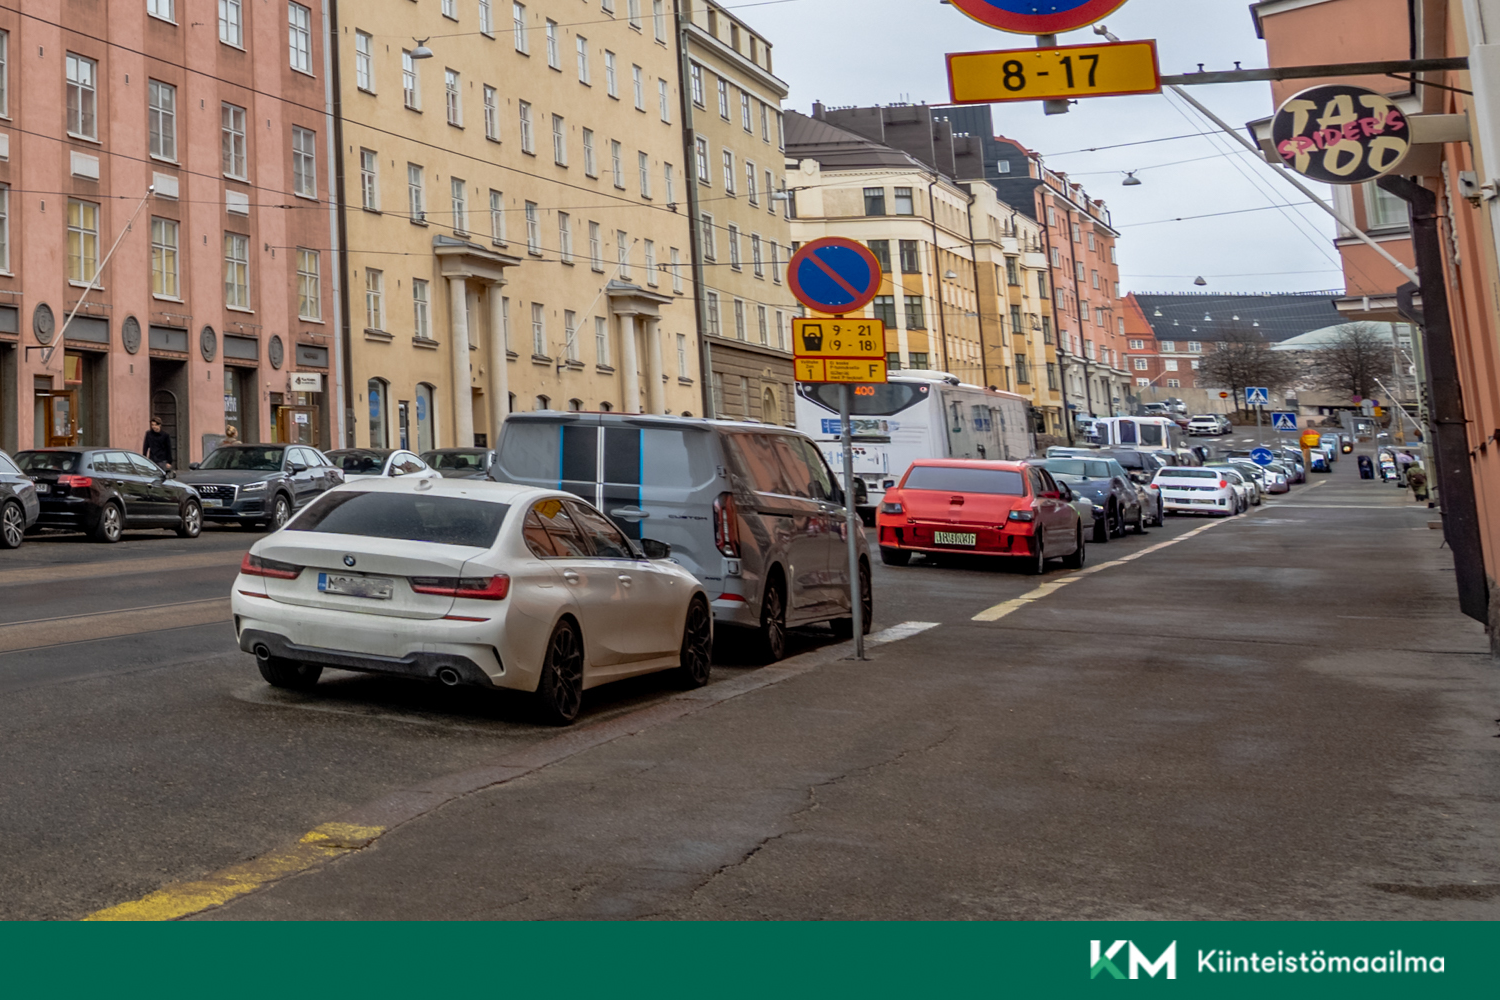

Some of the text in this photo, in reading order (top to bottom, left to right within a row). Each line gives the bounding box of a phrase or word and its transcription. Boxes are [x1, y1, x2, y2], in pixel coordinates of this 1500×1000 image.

[1283, 94, 1395, 137] TAT
[1278, 110, 1404, 160] SPIDER'S
[832, 325, 840, 336] 9
[858, 325, 871, 336] 21
[869, 364, 878, 378] F
[854, 386, 875, 396] 400
